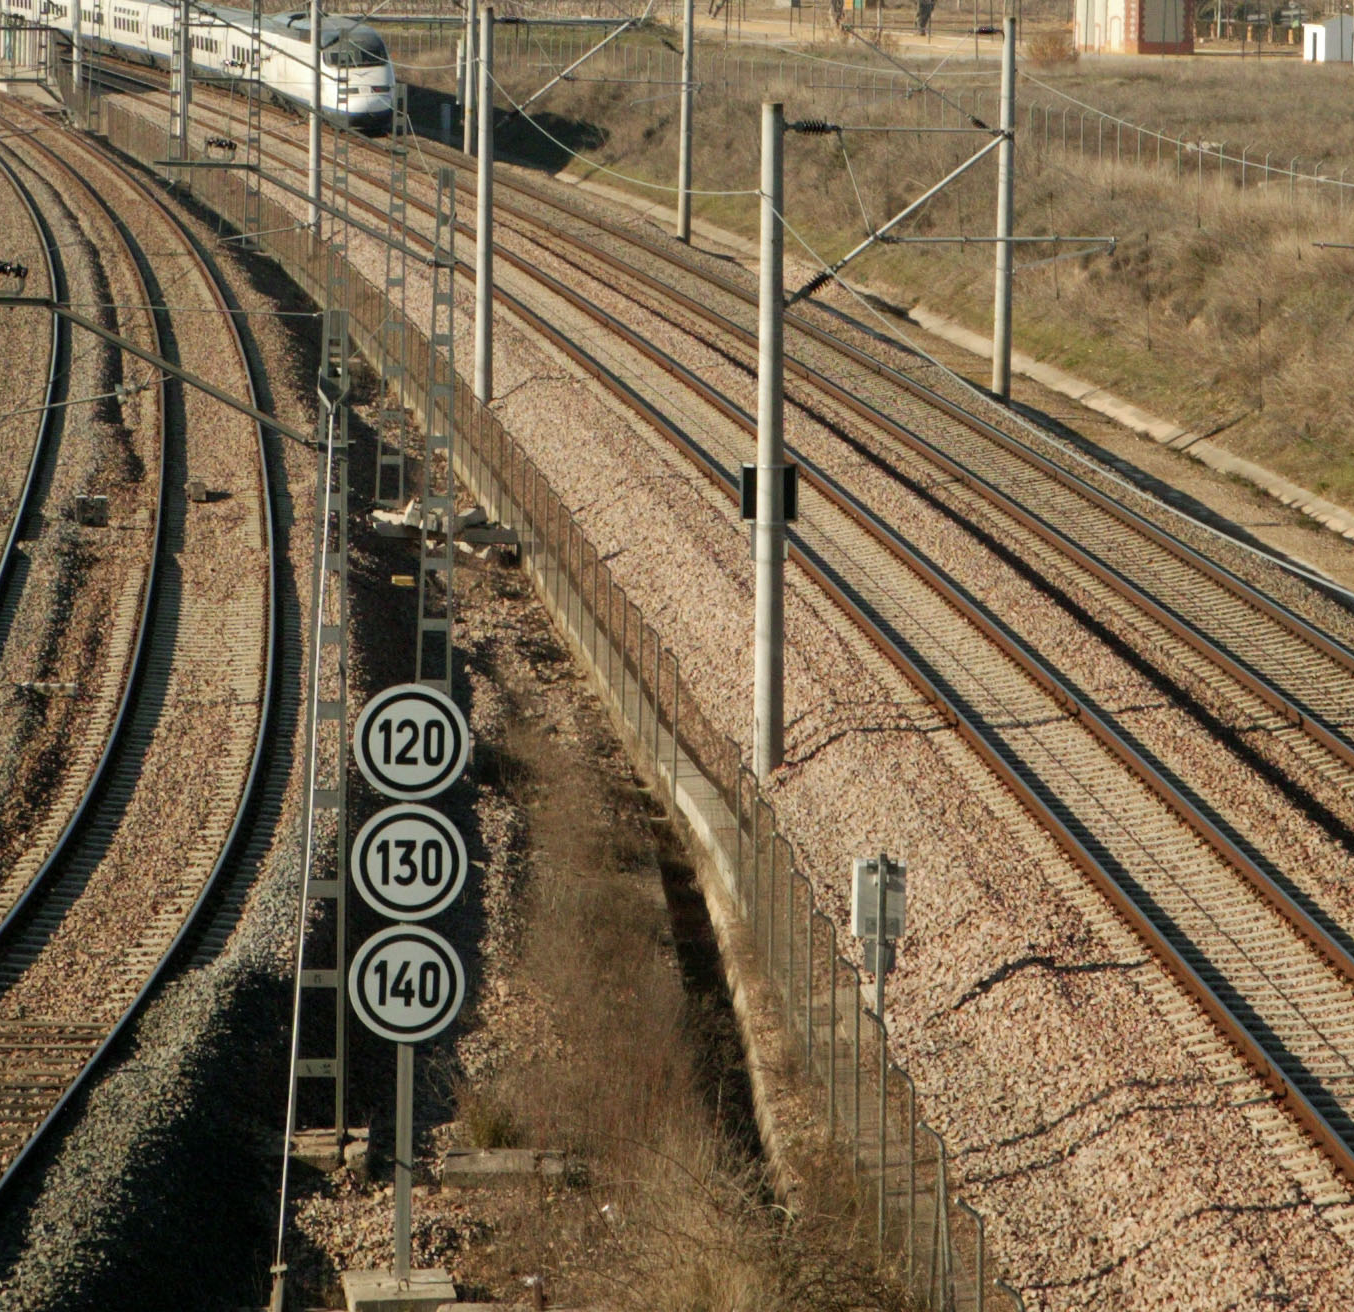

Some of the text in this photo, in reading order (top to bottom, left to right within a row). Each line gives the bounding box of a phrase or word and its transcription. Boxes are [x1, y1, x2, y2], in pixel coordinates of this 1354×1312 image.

[378, 719, 445, 766] 120
[376, 839, 443, 887] 130
[374, 960, 441, 1007] 140
